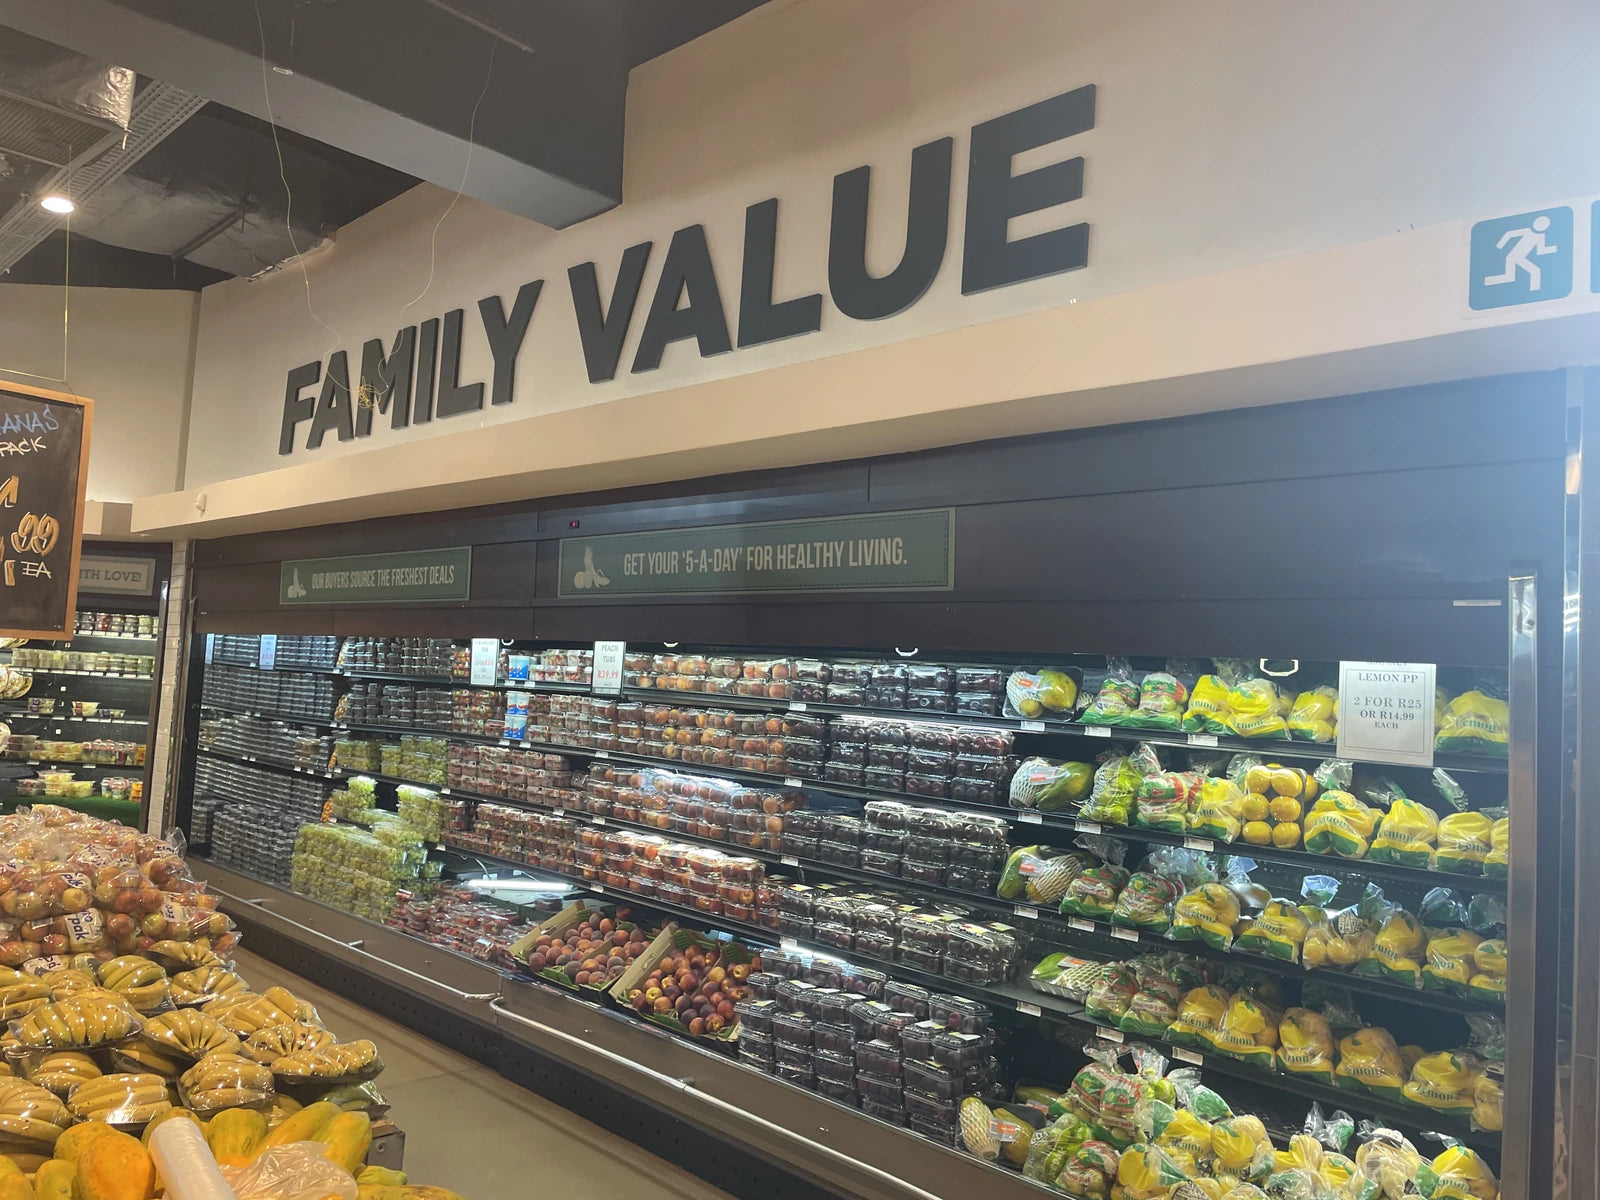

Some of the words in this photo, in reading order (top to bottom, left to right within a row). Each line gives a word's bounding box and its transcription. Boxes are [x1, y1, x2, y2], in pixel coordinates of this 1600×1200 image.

[278, 279, 544, 456] FAMILY
[568, 83, 1097, 385] VALUE
[0, 404, 59, 436] ANAS
[623, 552, 646, 576] GET
[647, 550, 679, 575] YOUR
[746, 545, 773, 571] FOR
[776, 540, 845, 570] HEALTHY
[848, 537, 908, 567] LIVING.
[79, 568, 101, 580] ITH
[104, 570, 142, 582] LOVE!
[311, 573, 324, 589] OUR
[325, 571, 349, 588] BUYERS
[350, 570, 376, 587] SOURCE
[377, 569, 391, 586] THE
[391, 566, 429, 585] FRESHEST
[429, 564, 455, 584] DEALS
[1358, 672, 1399, 682] LEMON
[1403, 674, 1418, 683] PP
[1353, 696, 1360, 705] 2
[1365, 697, 1393, 707] FOR
[1398, 698, 1422, 709] R25
[1360, 709, 1376, 718] OR
[1380, 710, 1415, 720] R14.99
[1374, 721, 1399, 729] EACH
[67, 917, 90, 941] pak
